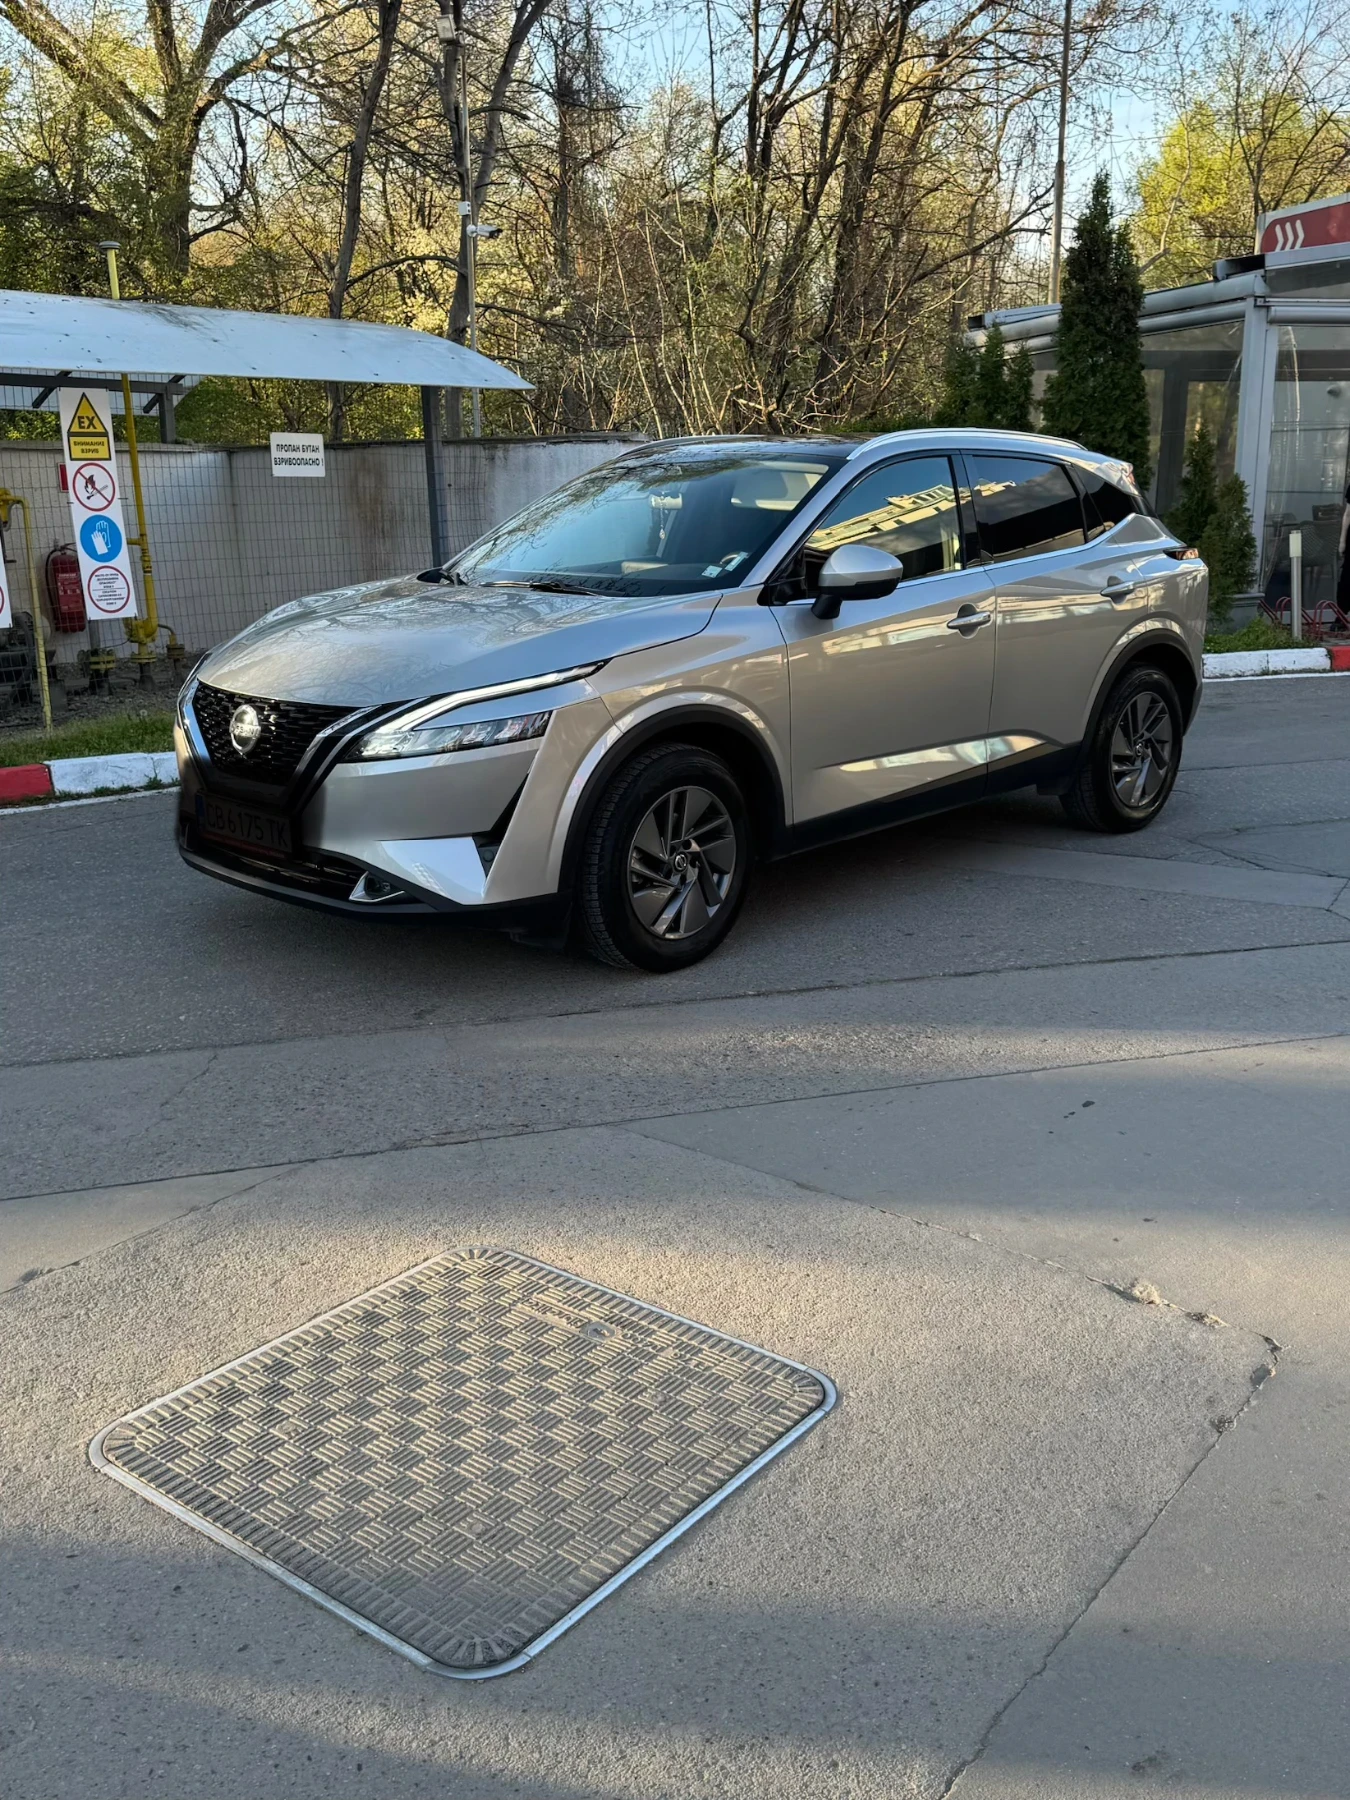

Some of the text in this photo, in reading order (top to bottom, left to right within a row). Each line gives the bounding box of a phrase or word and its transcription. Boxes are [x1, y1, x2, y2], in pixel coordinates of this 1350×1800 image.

[77, 415, 98, 430] EX
[276, 444, 320, 453] ПРОПАН БУТАН
[274, 457, 320, 466] ВЗРИВООПАСНО
